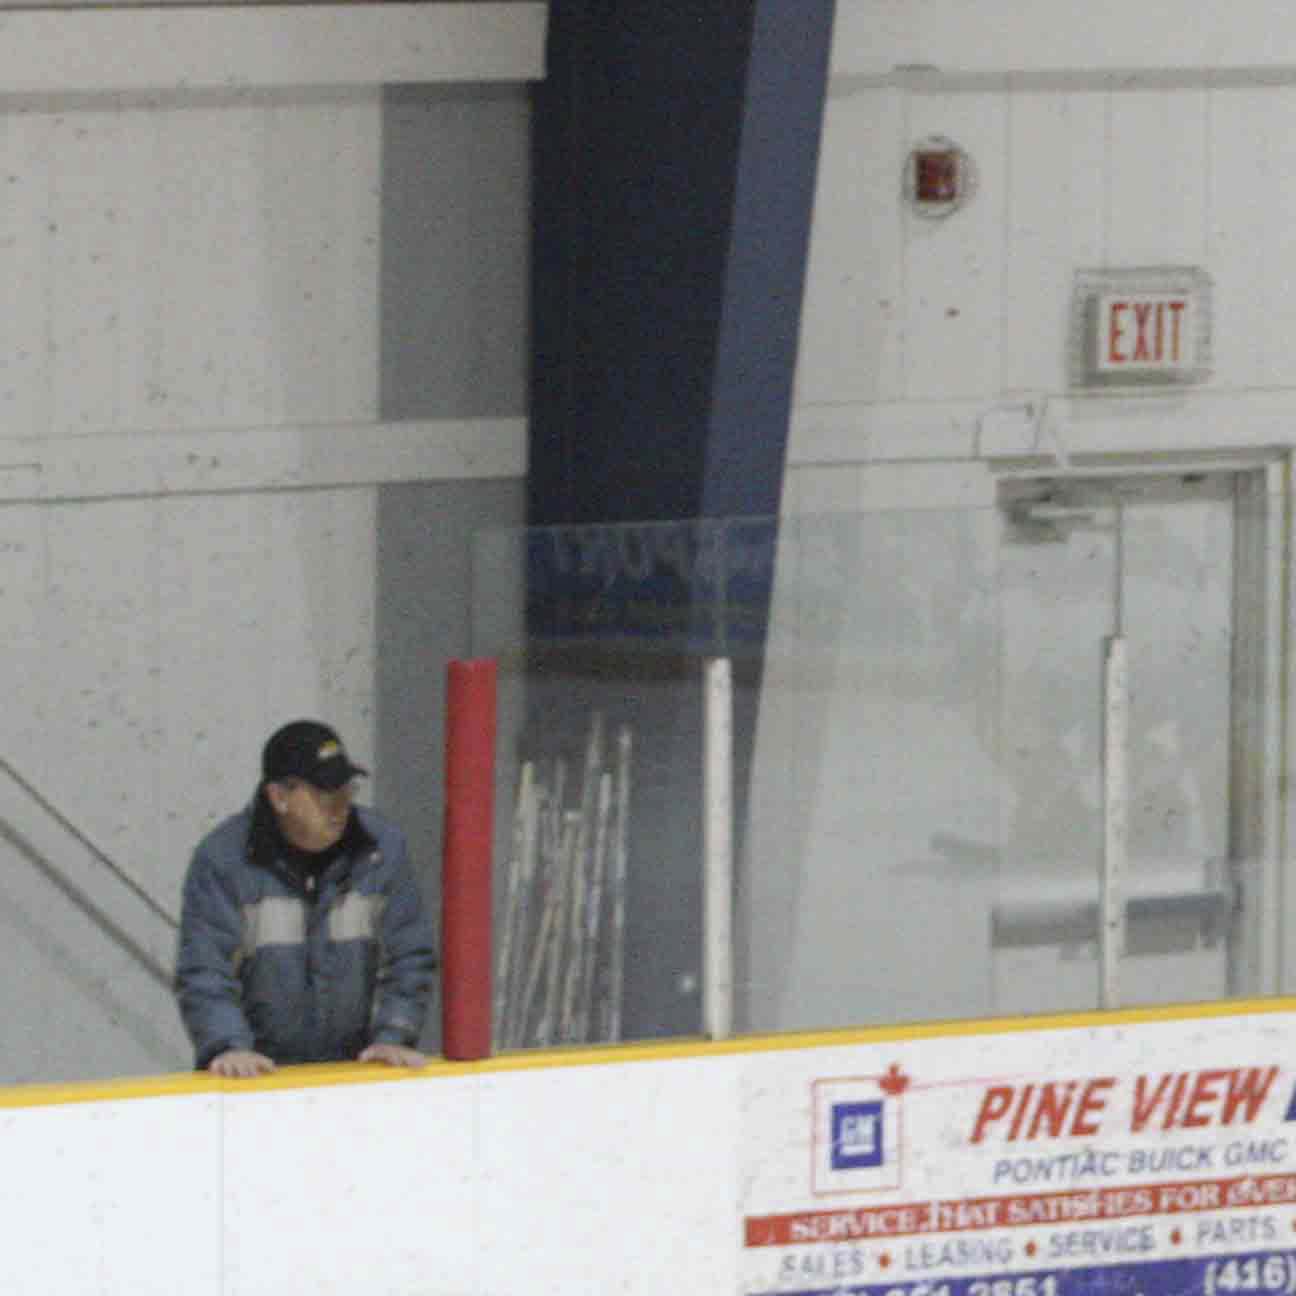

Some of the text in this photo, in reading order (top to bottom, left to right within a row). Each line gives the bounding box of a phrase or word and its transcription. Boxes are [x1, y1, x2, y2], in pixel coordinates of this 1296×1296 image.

[1107, 299, 1185, 363] EXIT
[968, 1065, 1280, 1144] PINE VIEW
[993, 1150, 1120, 1185] PONTIAC
[1127, 1144, 1211, 1174] BUICK
[1224, 1137, 1288, 1166] GMC
[790, 1208, 913, 1239] SERVICE
[1008, 1190, 1151, 1225] SATISFIES
[1161, 1183, 1220, 1211] FOR
[780, 1250, 865, 1279] SALES
[905, 1237, 1013, 1270] LEASING
[1049, 1226, 1155, 1260] SERVICE
[1196, 1215, 1279, 1246] PARTS
